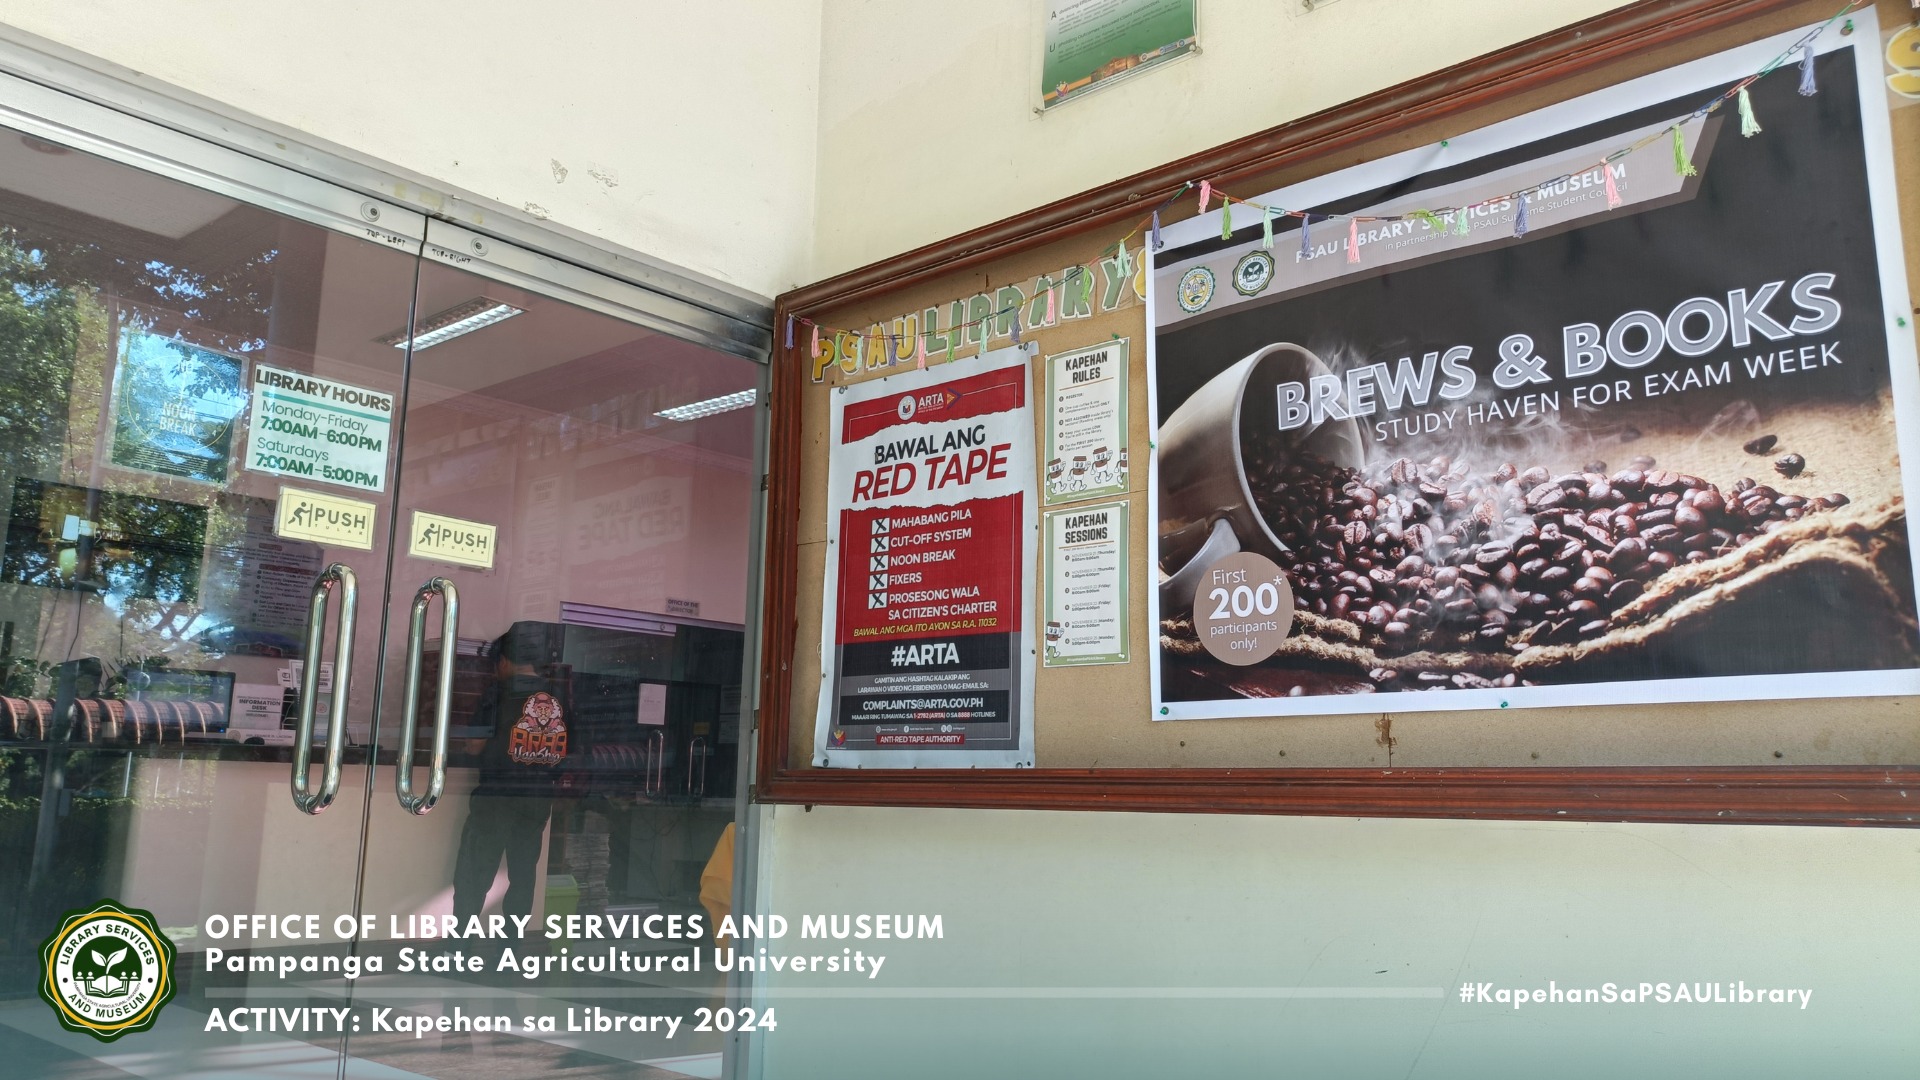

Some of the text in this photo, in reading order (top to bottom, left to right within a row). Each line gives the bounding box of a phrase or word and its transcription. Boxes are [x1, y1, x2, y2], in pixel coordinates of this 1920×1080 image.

[1395, 228, 1449, 250] partnership
[1473, 216, 1499, 231] PSAU
[1547, 195, 1587, 211] Student
[1343, 219, 1416, 251] LBRARY
[1065, 351, 1108, 371] KAPEHAN
[1276, 273, 1842, 431] BREWS & BOOKS
[1072, 367, 1100, 384] RULES
[256, 369, 391, 412] LIBRARY HOURS
[918, 392, 944, 408] ARTA
[1375, 341, 1843, 443] STUDY HAVEN FOR EXAM WEEK
[257, 437, 329, 461] Saturdays
[874, 424, 986, 465] BAWAL ANG
[852, 443, 1012, 503] RED TAPE
[315, 507, 367, 530] PUSH
[892, 508, 972, 529] MAHABANG PILA
[1065, 512, 1108, 529] KAPEHAN
[442, 528, 488, 549] PUSH
[890, 527, 972, 548] CUT-OFF SYSTEM
[1065, 527, 1108, 544] SESSIONS
[890, 549, 956, 566] NOON BREAK
[889, 572, 922, 586] FIXERS
[1213, 568, 1247, 585] First
[889, 586, 980, 604] PROSESONG WALA
[888, 601, 997, 620] SA CITIZEN'S CHARTER
[854, 625, 878, 637] BAWAL
[880, 624, 895, 635] ANG
[896, 623, 914, 633] MGA
[914, 622, 928, 632] ITO
[929, 621, 950, 631] AYON
[950, 620, 961, 629] SA
[962, 619, 977, 629] R.A.
[1210, 620, 1278, 638] participants
[1230, 637, 1258, 652] only!
[890, 642, 960, 667] #ARTA
[863, 698, 984, 711] COMPLAINTS@ARTA.GOV.PH
[879, 735, 961, 743] ANTI-RED TAPE AUTHORITY
